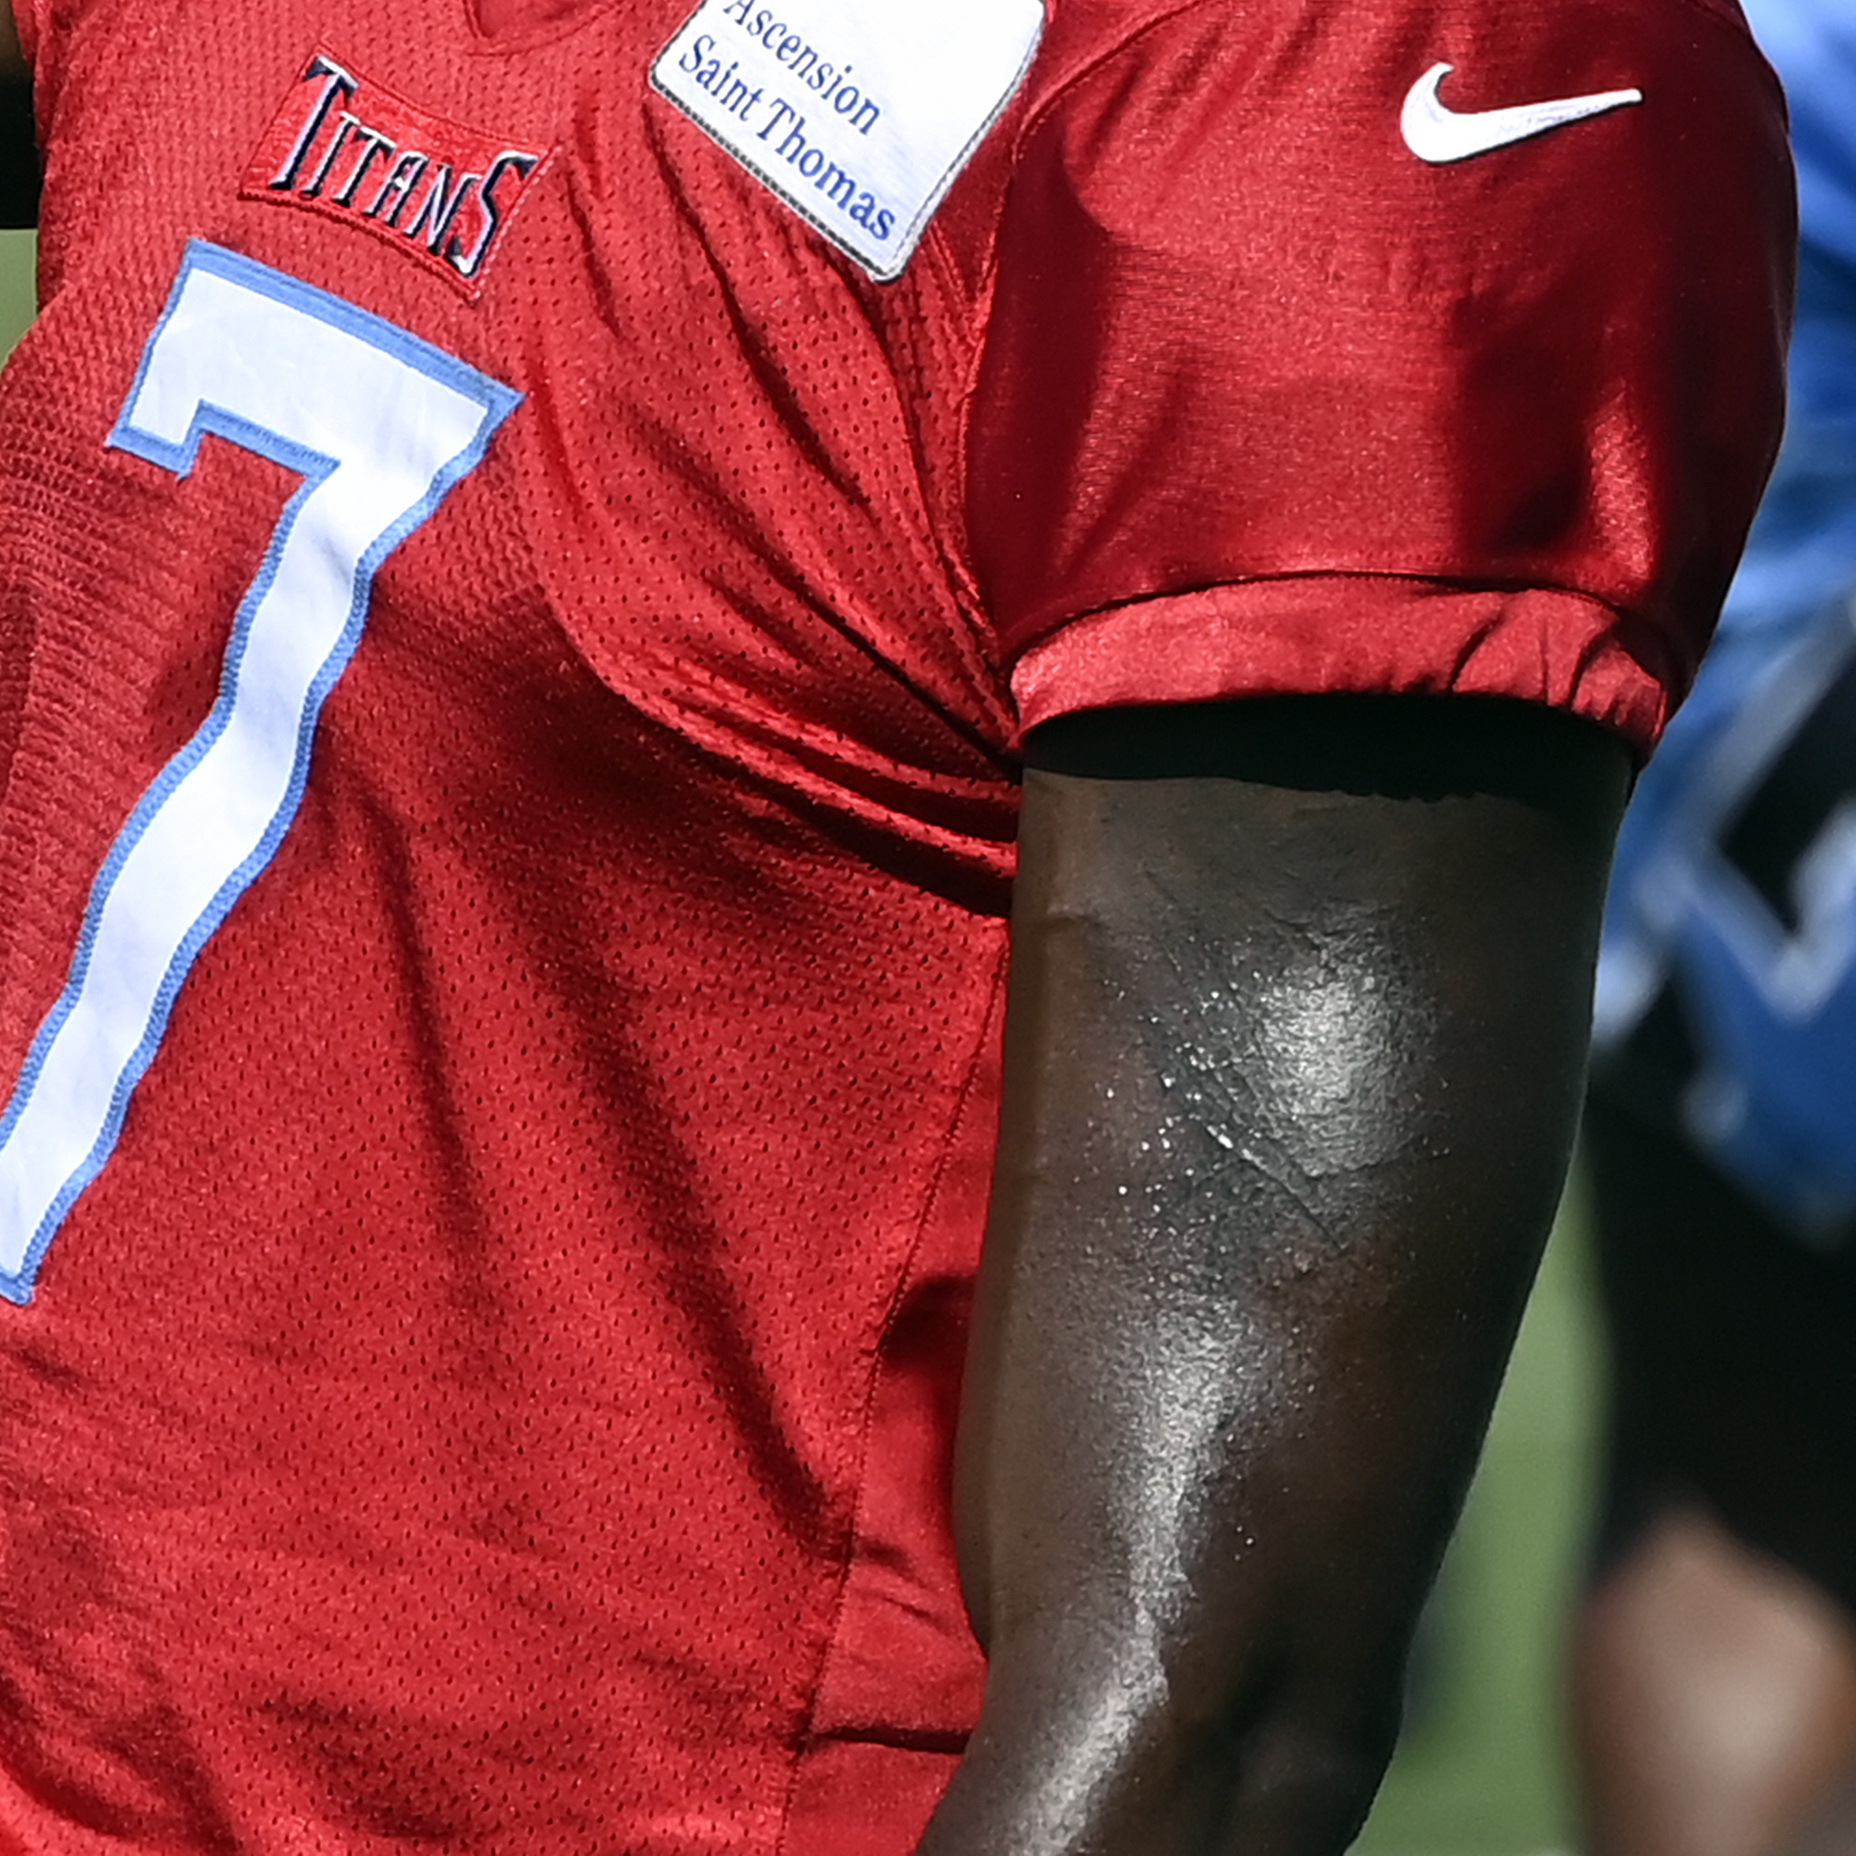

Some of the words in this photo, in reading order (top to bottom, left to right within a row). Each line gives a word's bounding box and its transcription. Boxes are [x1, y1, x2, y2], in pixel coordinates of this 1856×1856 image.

[266, 52, 541, 281] TITANS
[678, 33, 765, 122] Saint
[755, 97, 895, 241] Thomas
